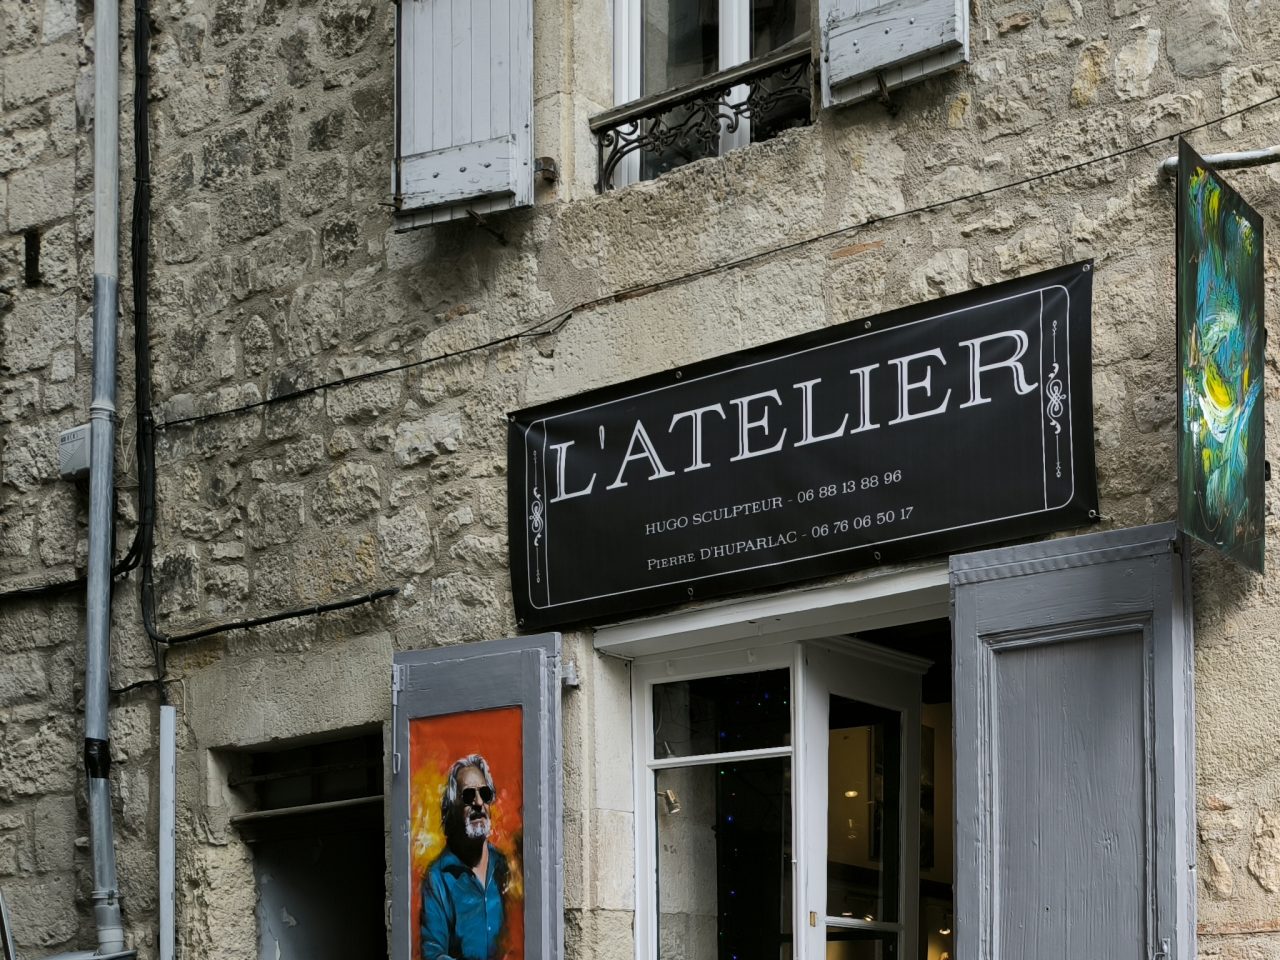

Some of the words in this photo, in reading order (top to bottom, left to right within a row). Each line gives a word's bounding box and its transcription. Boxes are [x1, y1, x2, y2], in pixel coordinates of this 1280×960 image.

[549, 328, 1039, 504] L'ATELIER
[645, 516, 689, 536] HUGO
[692, 496, 783, 526] SCULPTEUR
[797, 489, 815, 504] 06
[818, 484, 837, 499] 88
[841, 480, 856, 494] 13
[860, 474, 879, 490] 88
[883, 469, 902, 485] 96
[699, 531, 798, 561] D'HUPARLAC
[811, 523, 829, 539] 06
[832, 519, 849, 534] 76
[853, 514, 872, 530] 06
[876, 510, 895, 525] 50
[899, 506, 914, 521] 17
